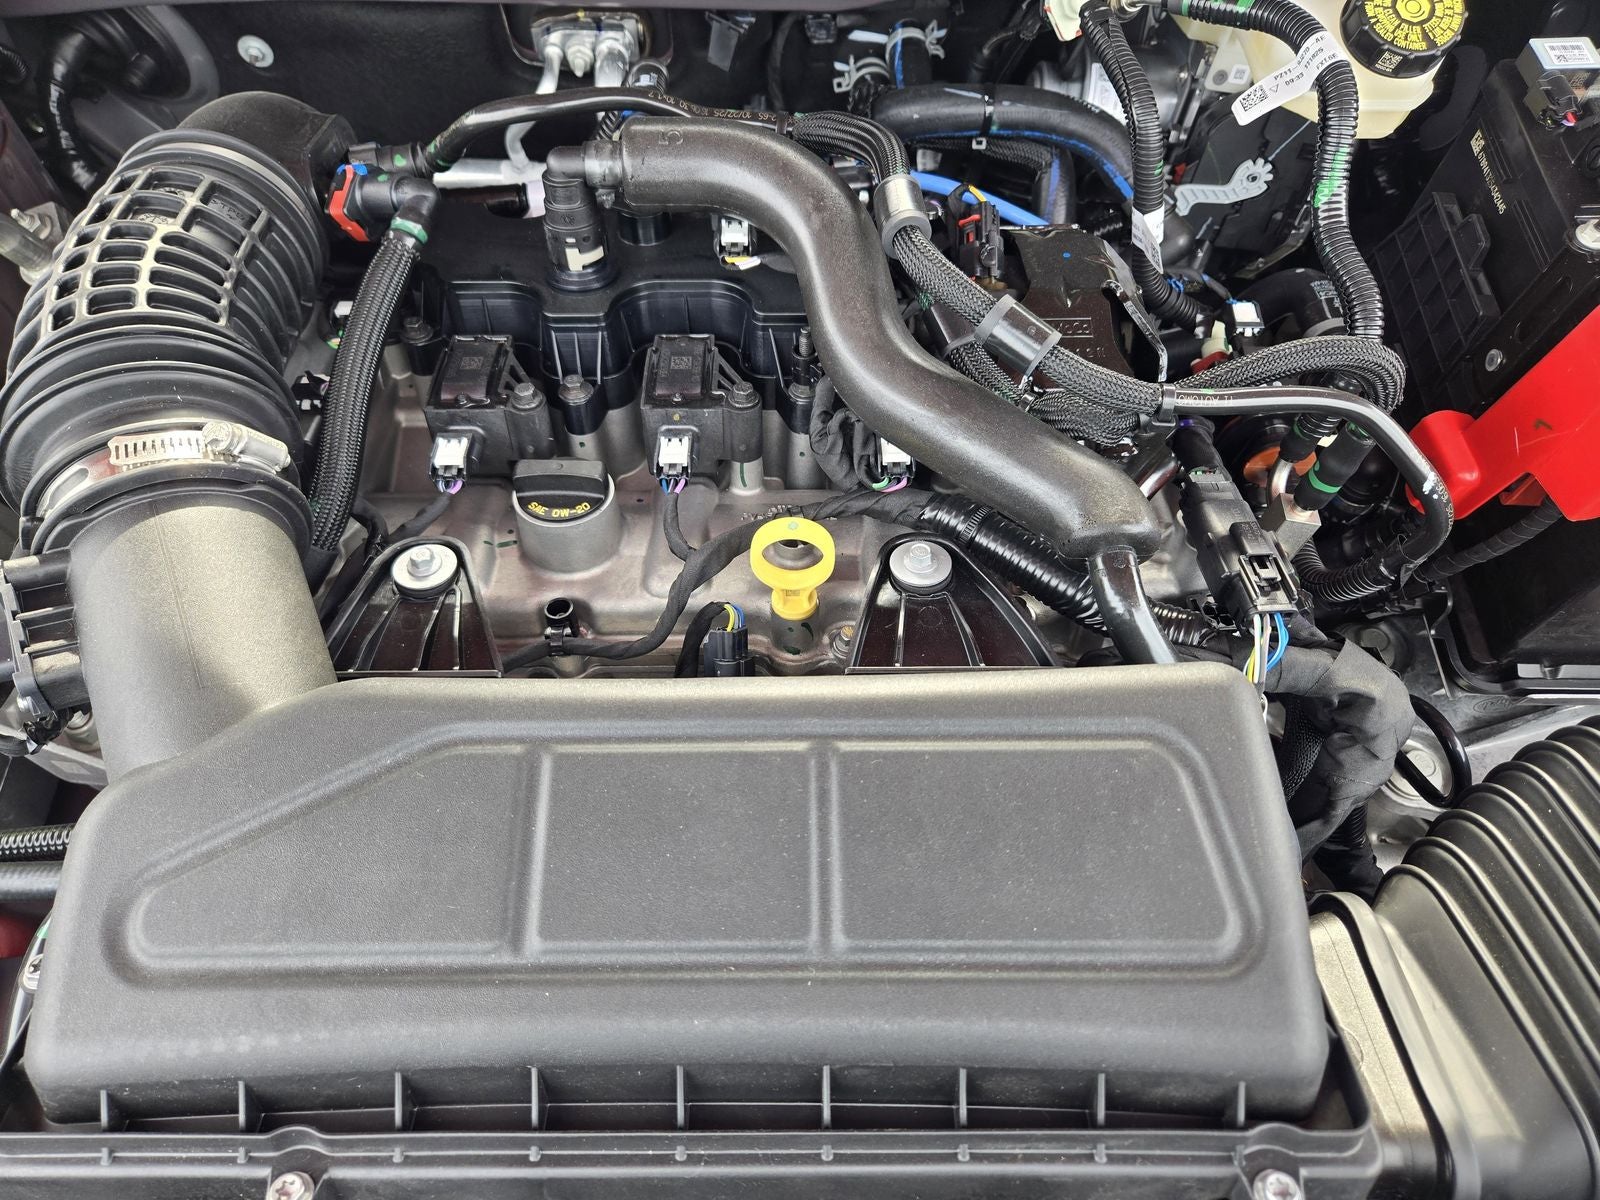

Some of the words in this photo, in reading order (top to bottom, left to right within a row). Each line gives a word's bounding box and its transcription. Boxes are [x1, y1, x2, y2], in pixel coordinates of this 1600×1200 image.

[1373, 22, 1394, 42] SEALED
[527, 501, 549, 516] SAE
[551, 501, 592, 518] 0W-20
